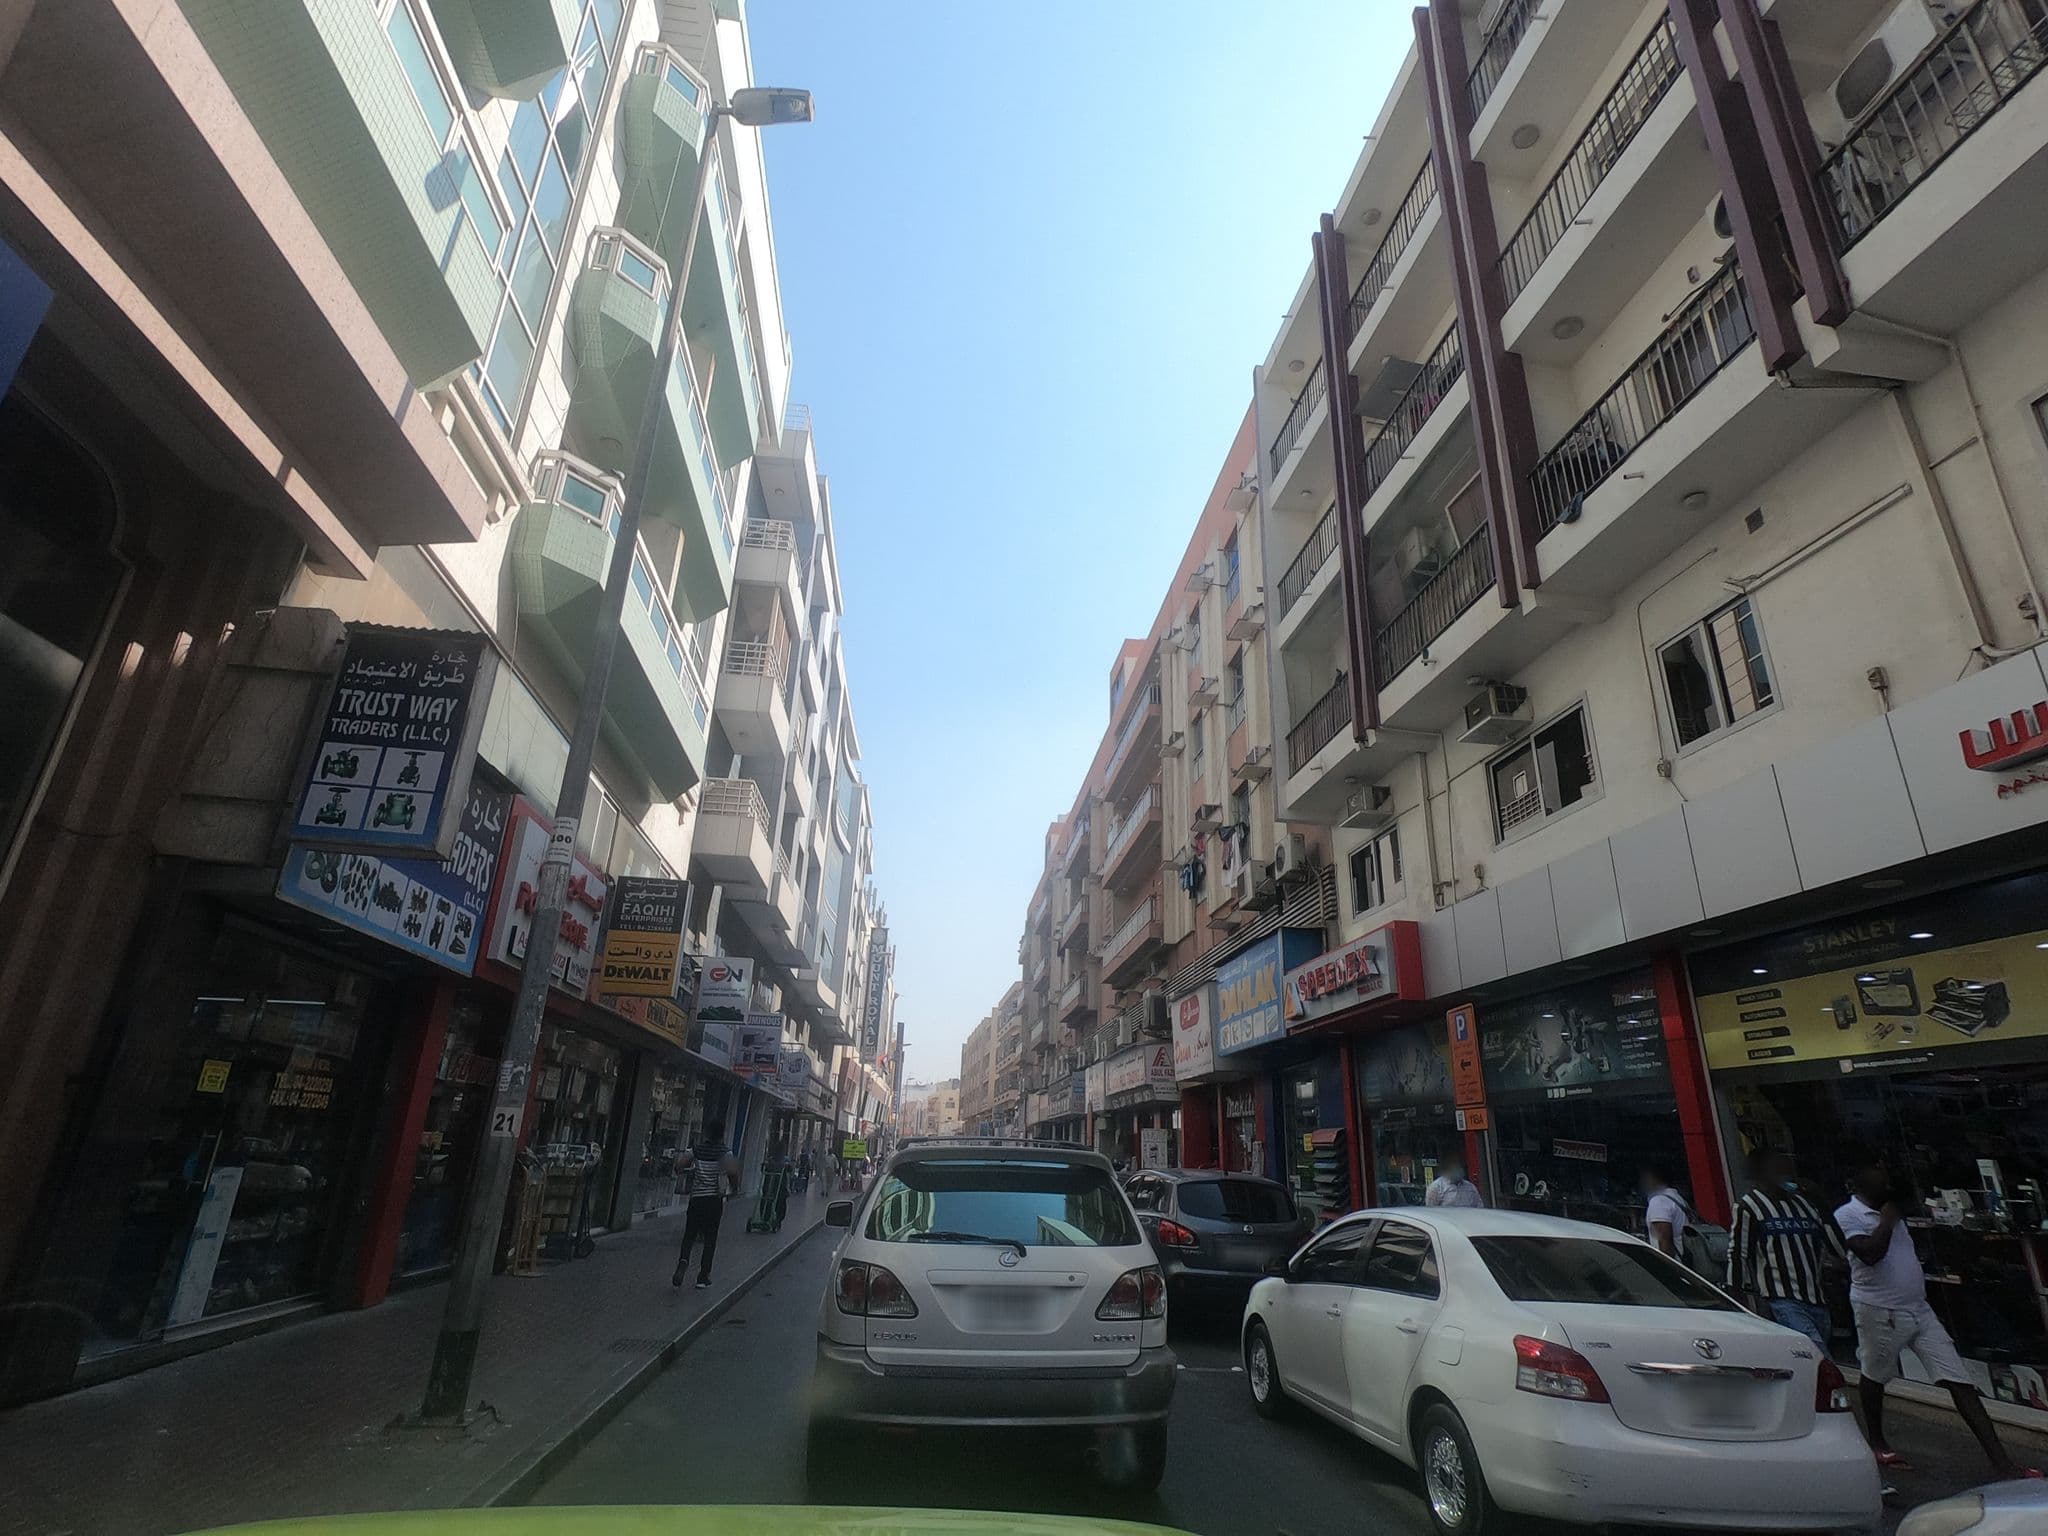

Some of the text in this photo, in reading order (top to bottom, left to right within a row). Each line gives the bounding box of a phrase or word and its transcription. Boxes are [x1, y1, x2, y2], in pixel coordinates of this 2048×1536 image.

[347, 658, 465, 688] طريق الاعتماد
[338, 688, 459, 724] TRUST WAY
[331, 718, 398, 738] TRADERS
[442, 831, 494, 893] ADERS
[620, 914, 674, 924] ENTERPRISES
[622, 903, 675, 917] FAQIHI
[1803, 921, 1896, 953] STANLEY
[1219, 961, 1278, 1022] DAHLAK
[494, 1113, 515, 1132] 21
